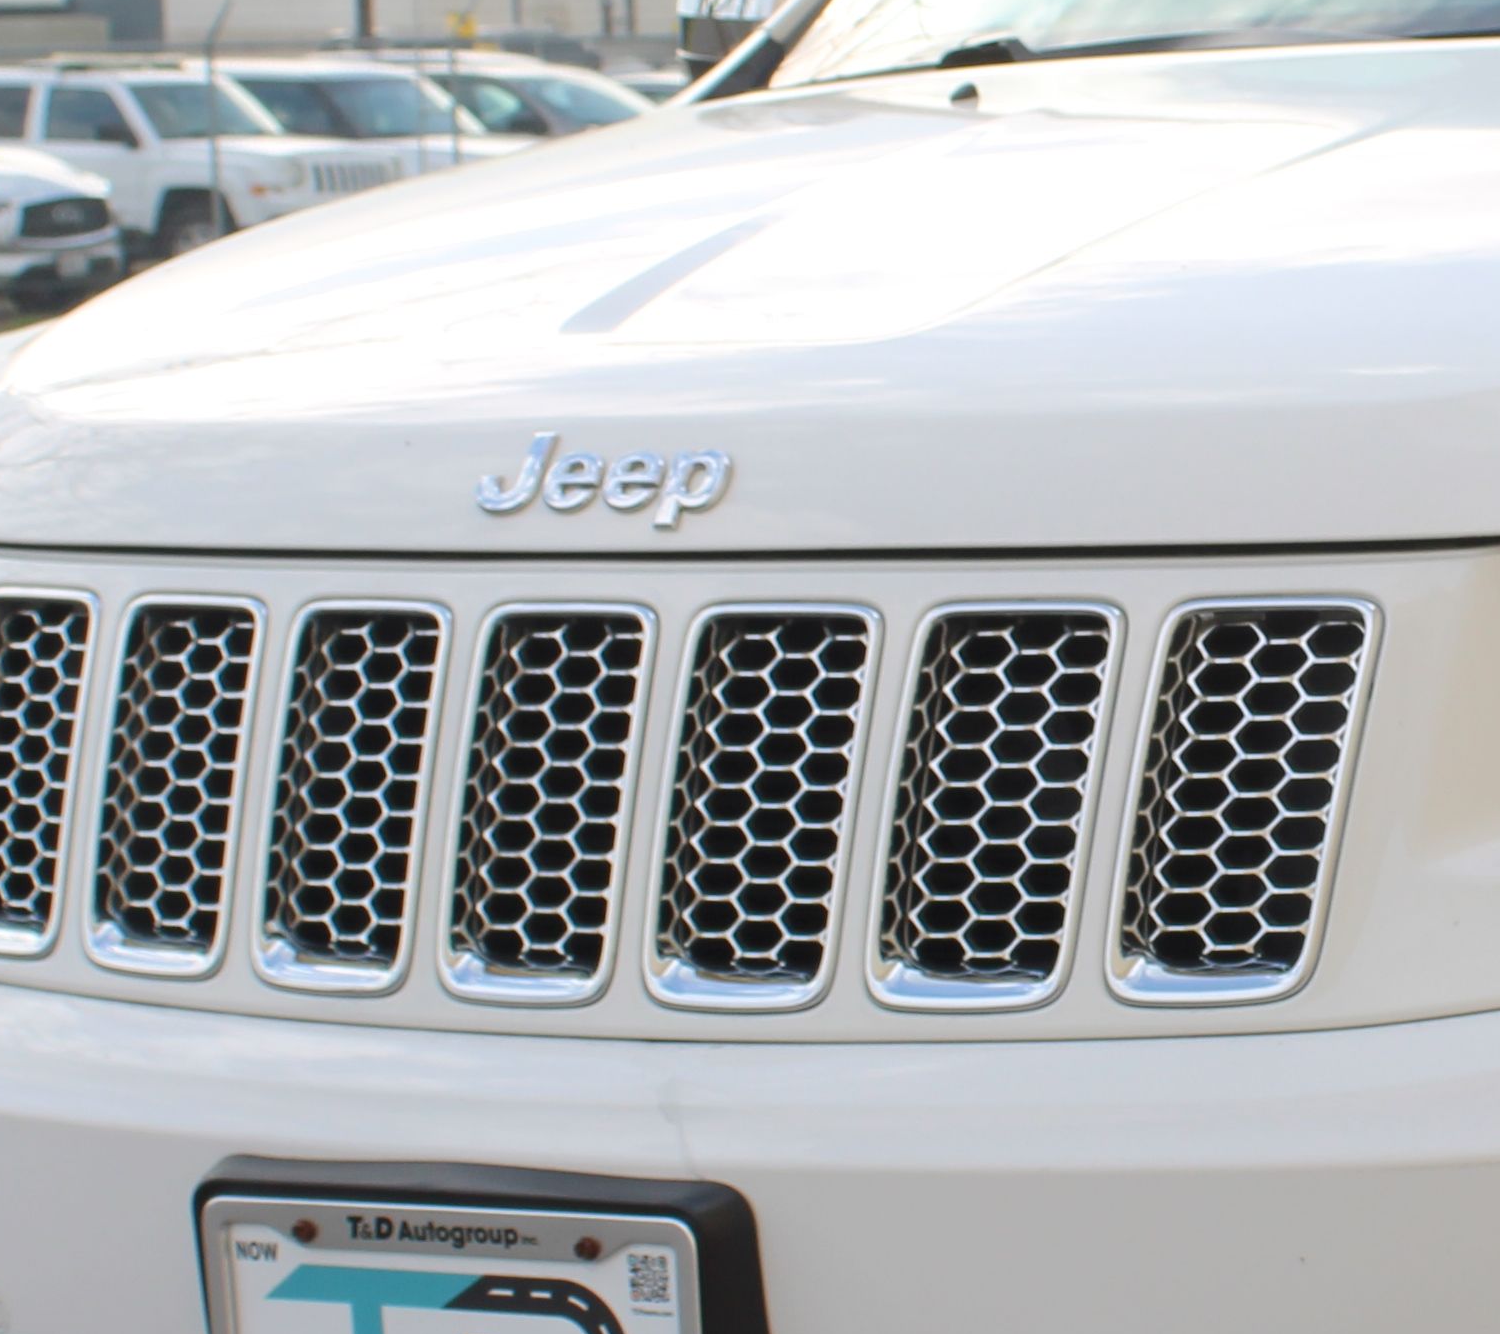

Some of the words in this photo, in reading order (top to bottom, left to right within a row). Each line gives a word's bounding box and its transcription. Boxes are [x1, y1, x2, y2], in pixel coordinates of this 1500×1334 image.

[475, 431, 732, 530] Jeep
[346, 1215, 394, 1240] T&D
[398, 1221, 518, 1248] Autogroup
[235, 1240, 278, 1261] NOW
